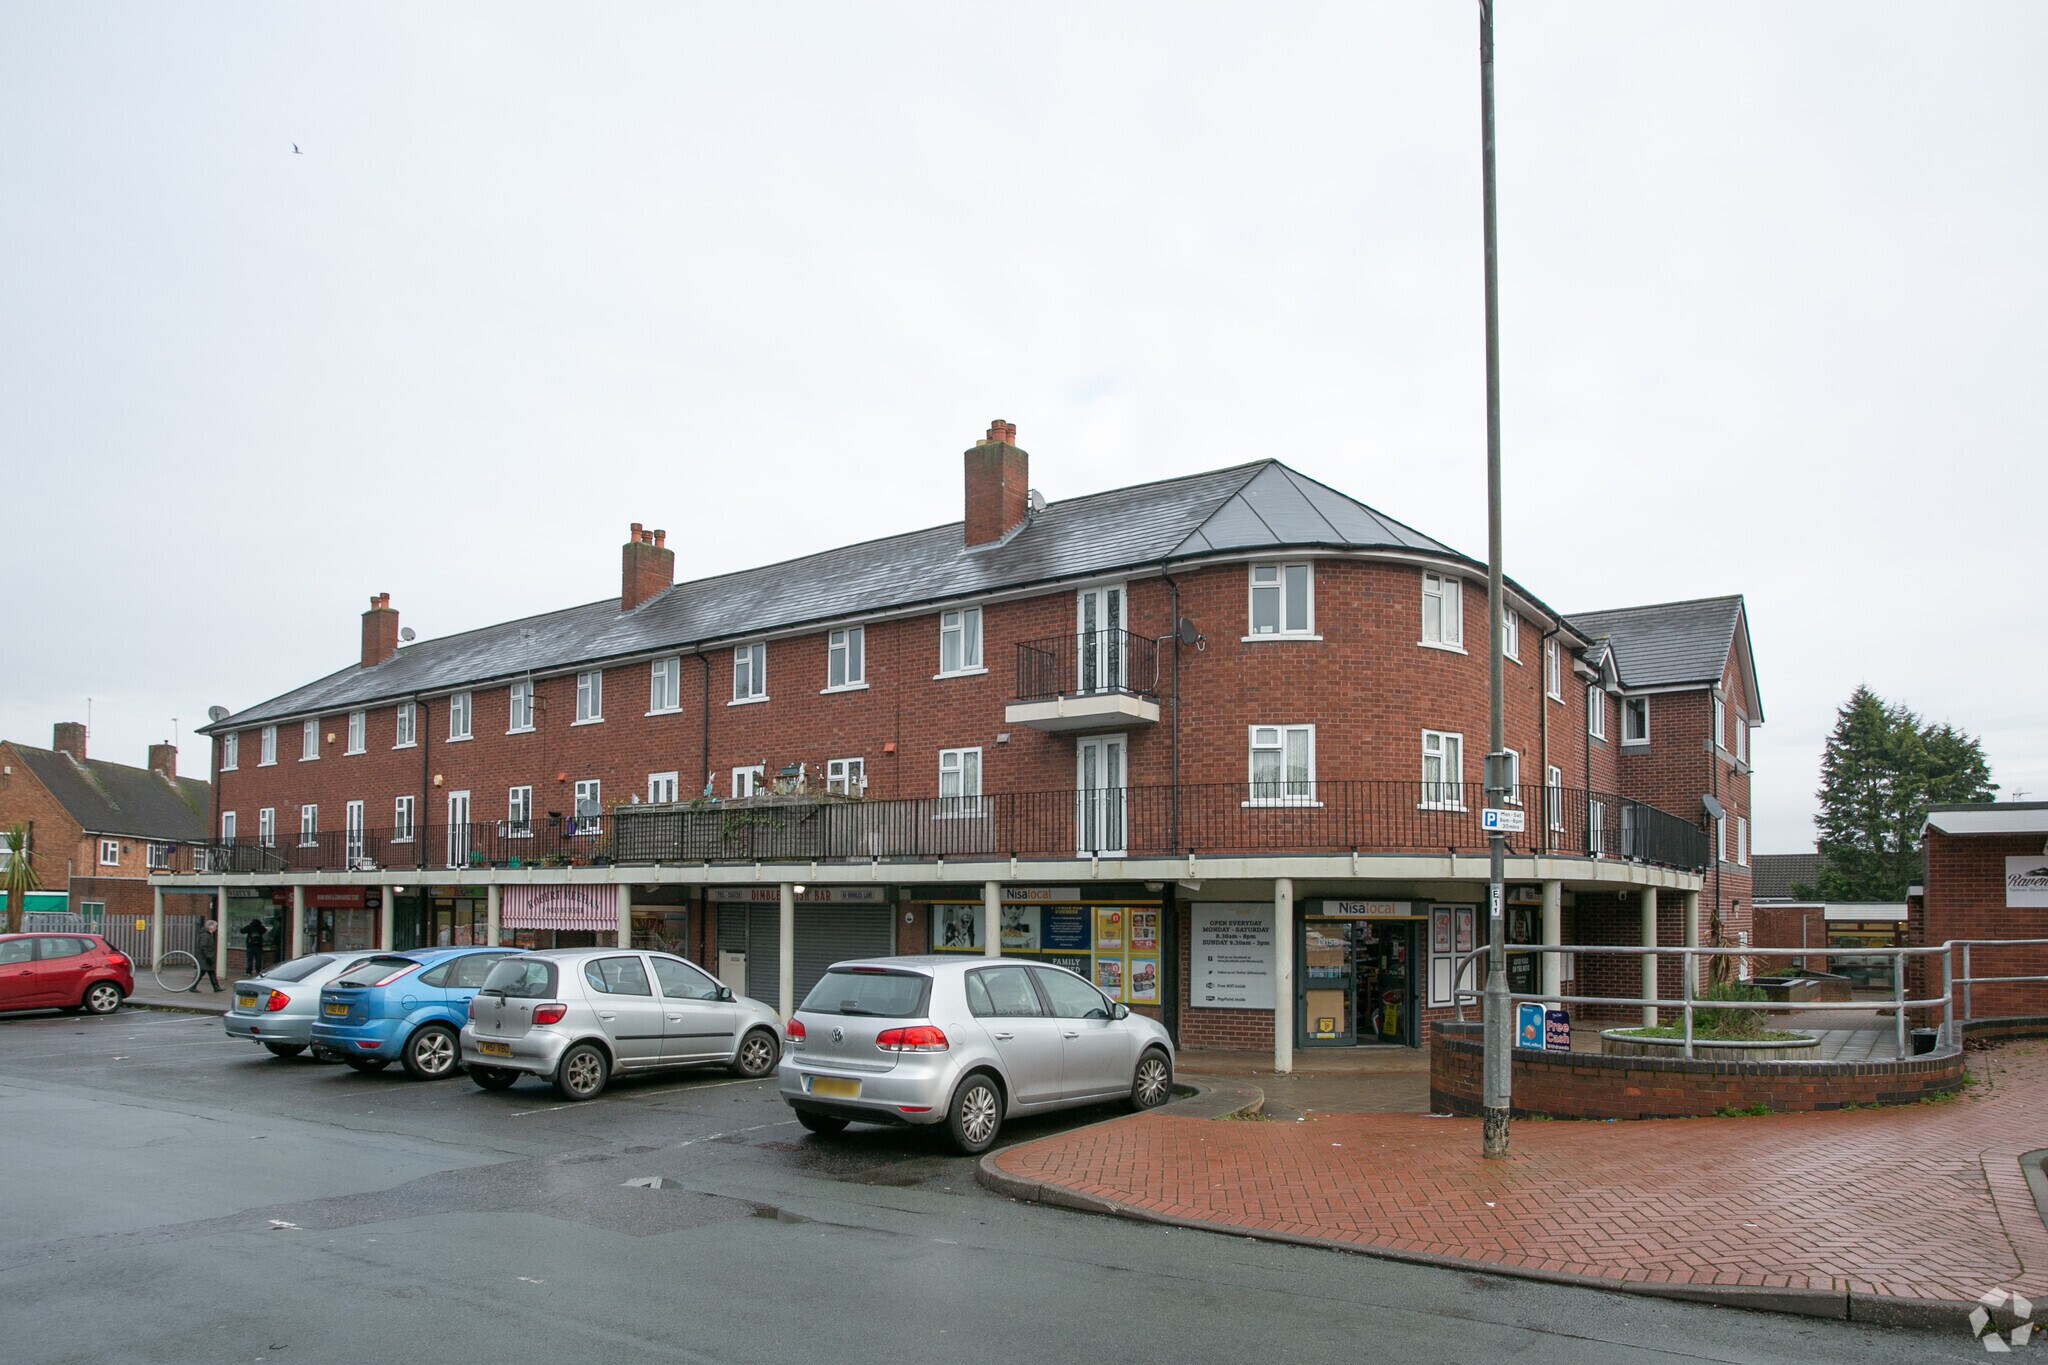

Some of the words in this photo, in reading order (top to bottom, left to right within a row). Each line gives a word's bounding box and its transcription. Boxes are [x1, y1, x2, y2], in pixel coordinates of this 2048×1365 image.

[1487, 812, 1496, 826] P
[752, 890, 780, 900] DIMBLE
[814, 890, 831, 900] BAR
[1052, 958, 1080, 966] FAMILY
[1546, 1020, 1569, 1033] Free
[1546, 1032, 1569, 1044] Cash
